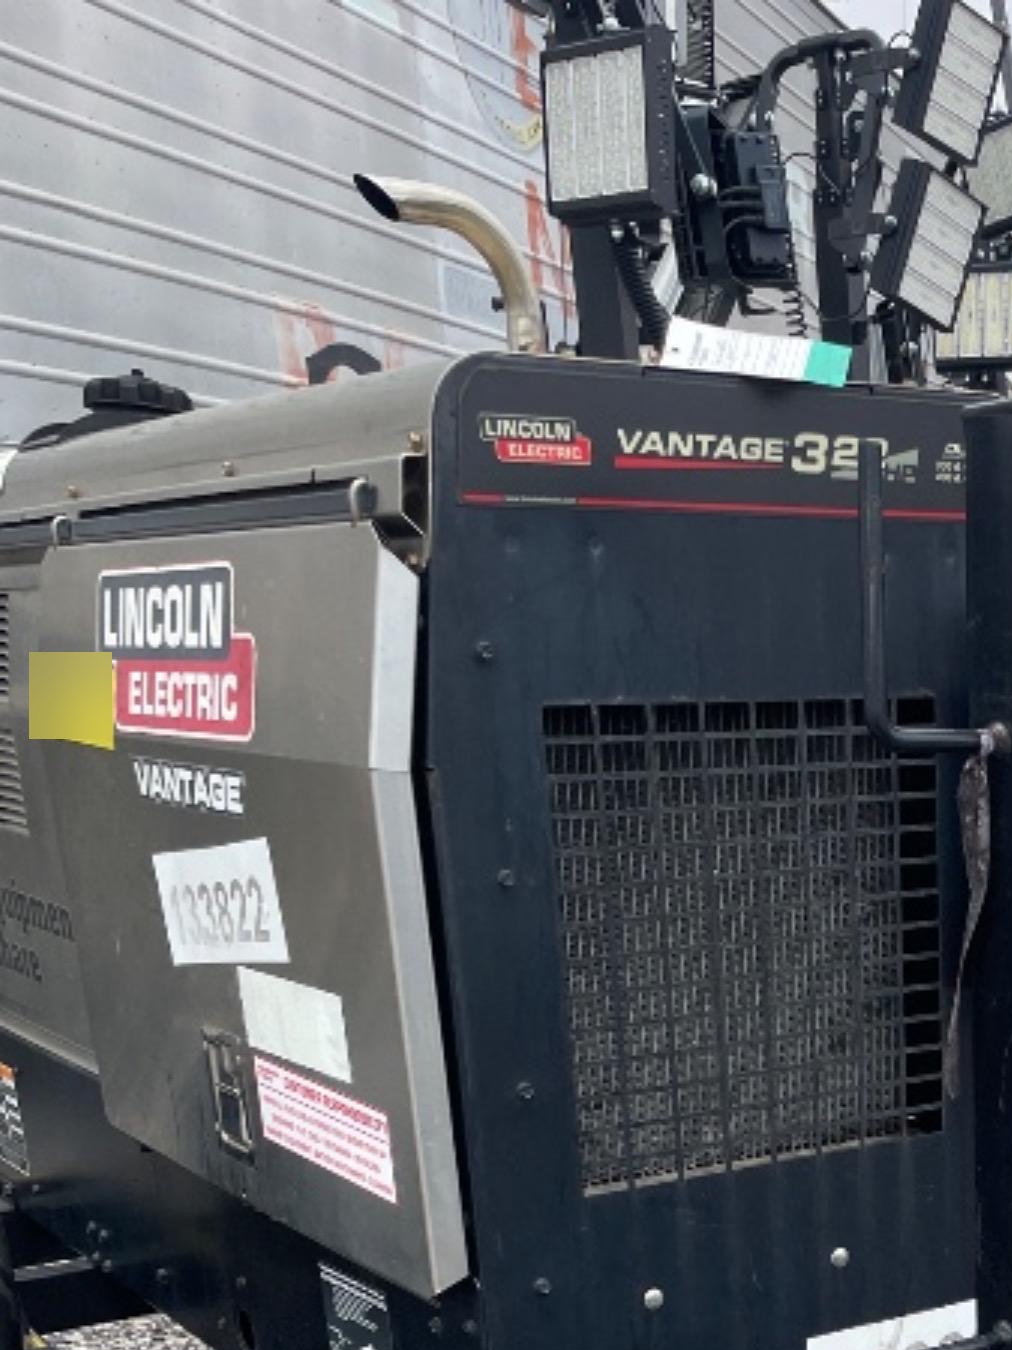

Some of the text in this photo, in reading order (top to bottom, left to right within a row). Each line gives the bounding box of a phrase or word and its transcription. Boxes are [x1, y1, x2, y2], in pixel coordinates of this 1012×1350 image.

[484, 418, 571, 442] LINCOLN
[616, 428, 785, 463] VANTAGE
[508, 443, 584, 460] ELECTRIC
[103, 581, 224, 649] LINCOLN
[127, 671, 239, 721] ELECTRIC
[133, 761, 245, 814] VANTAGE
